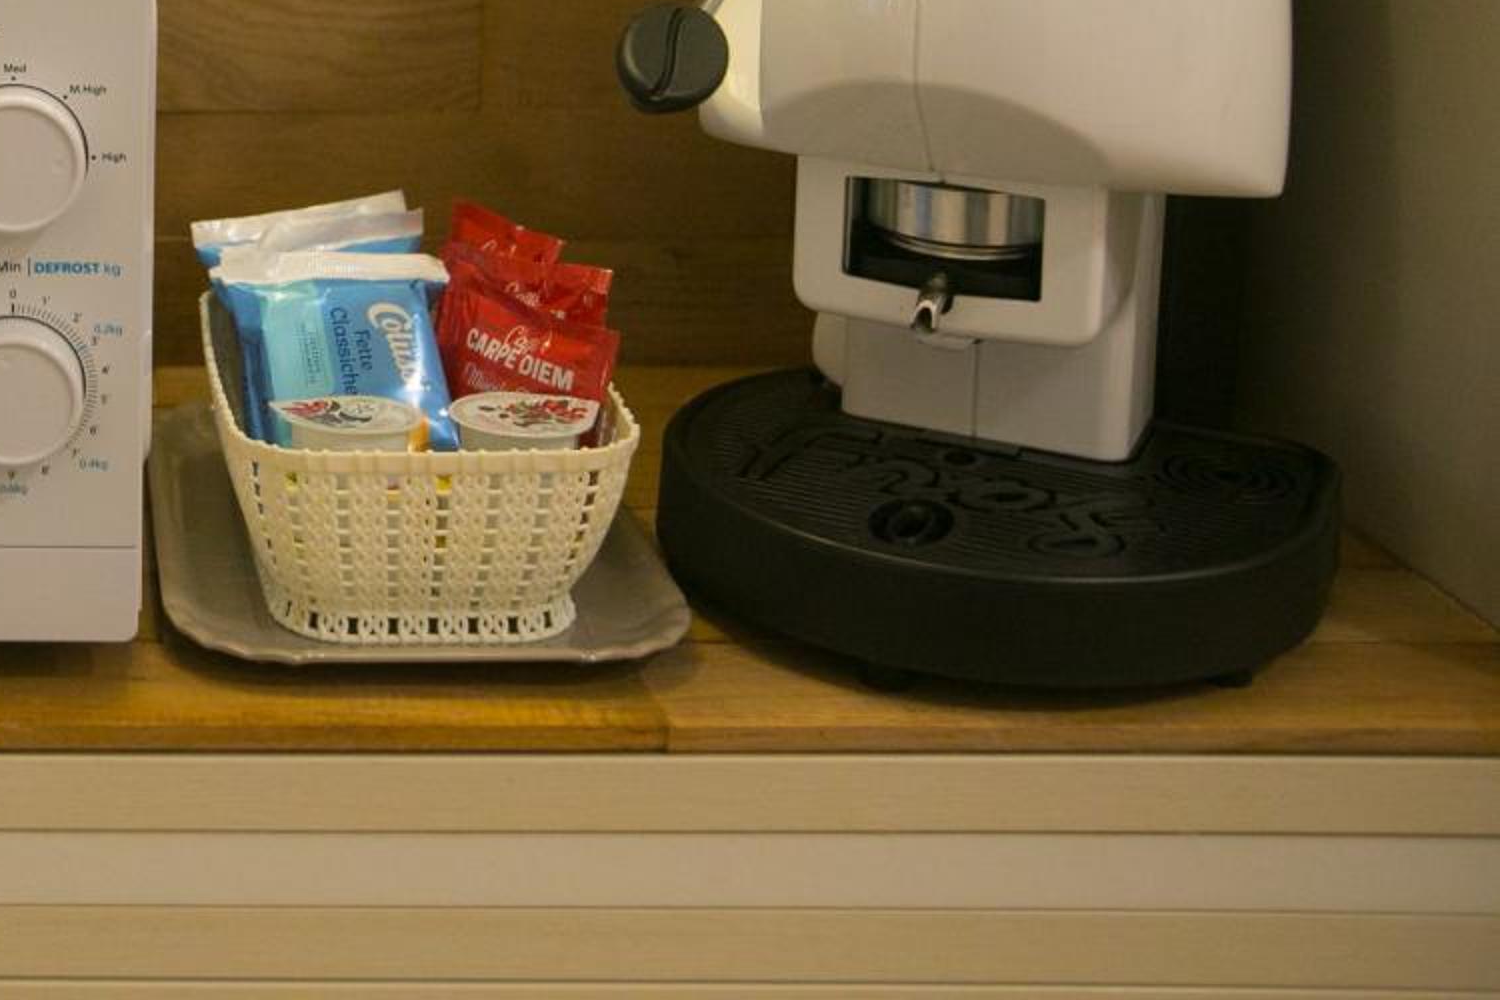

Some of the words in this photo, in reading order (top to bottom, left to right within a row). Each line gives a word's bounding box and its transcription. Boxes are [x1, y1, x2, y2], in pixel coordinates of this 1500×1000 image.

[3, 63, 27, 73] Med
[101, 152, 126, 163] High
[34, 260, 100, 275] DEFROST
[329, 306, 359, 394] Classiche
[354, 329, 373, 371] Fette
[366, 302, 432, 392] Colusi
[466, 327, 517, 370] CARPE
[518, 354, 576, 392] DIEM
